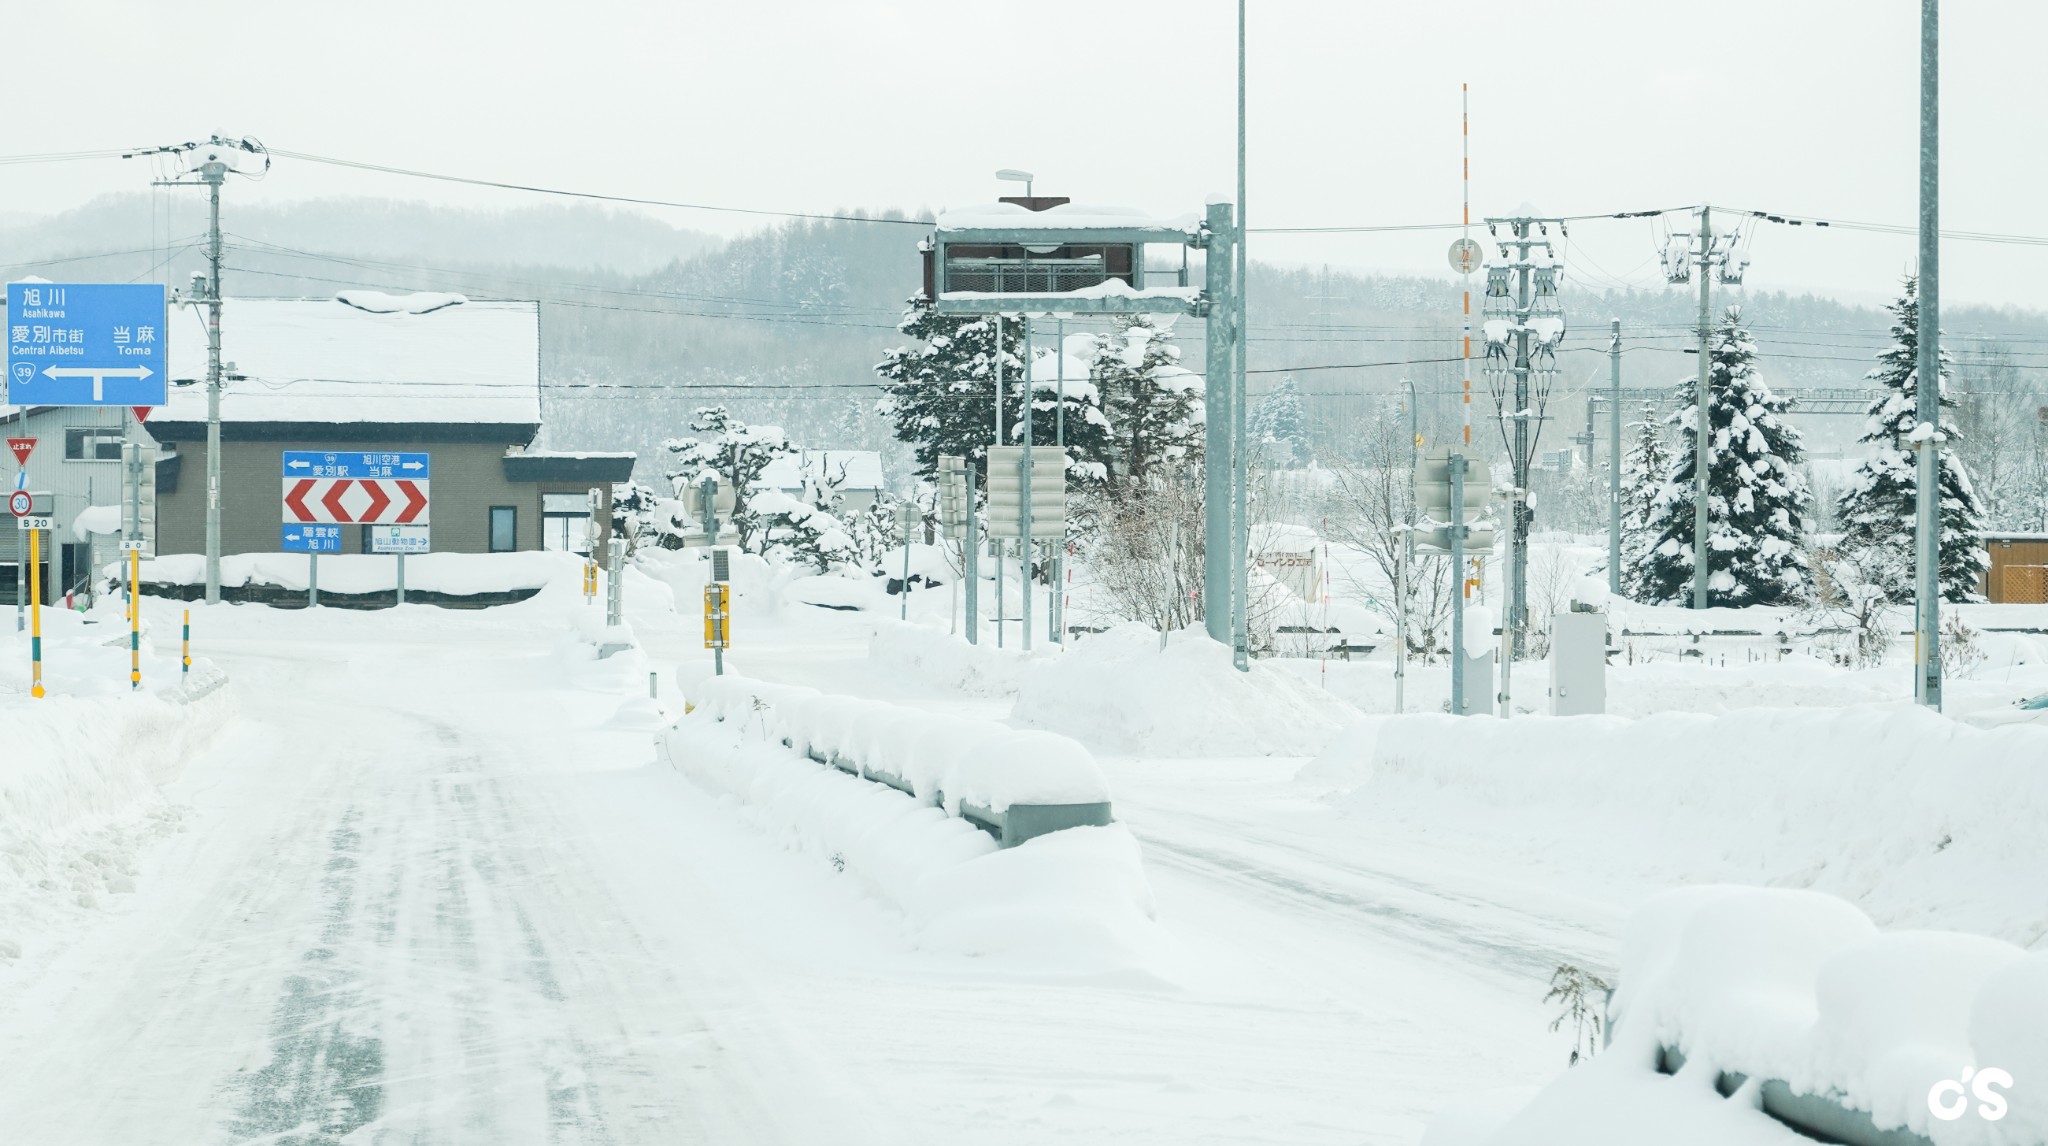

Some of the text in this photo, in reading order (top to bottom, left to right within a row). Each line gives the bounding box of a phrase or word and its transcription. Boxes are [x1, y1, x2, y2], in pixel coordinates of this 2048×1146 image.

[23, 288, 65, 306] 旭川
[23, 309, 65, 318] Asahikawa
[12, 325, 84, 343] 愛別市街
[113, 325, 155, 343] 当麻
[12, 346, 84, 355] Central Aibetsu
[117, 346, 151, 355] Toma
[17, 367, 32, 377] 39
[363, 454, 400, 466] 旭川空港
[313, 465, 349, 477] 愛別駅
[369, 466, 393, 477] 当麻
[14, 498, 28, 510] 30
[24, 519, 48, 527] B 20
[308, 538, 334, 549] 旭川
